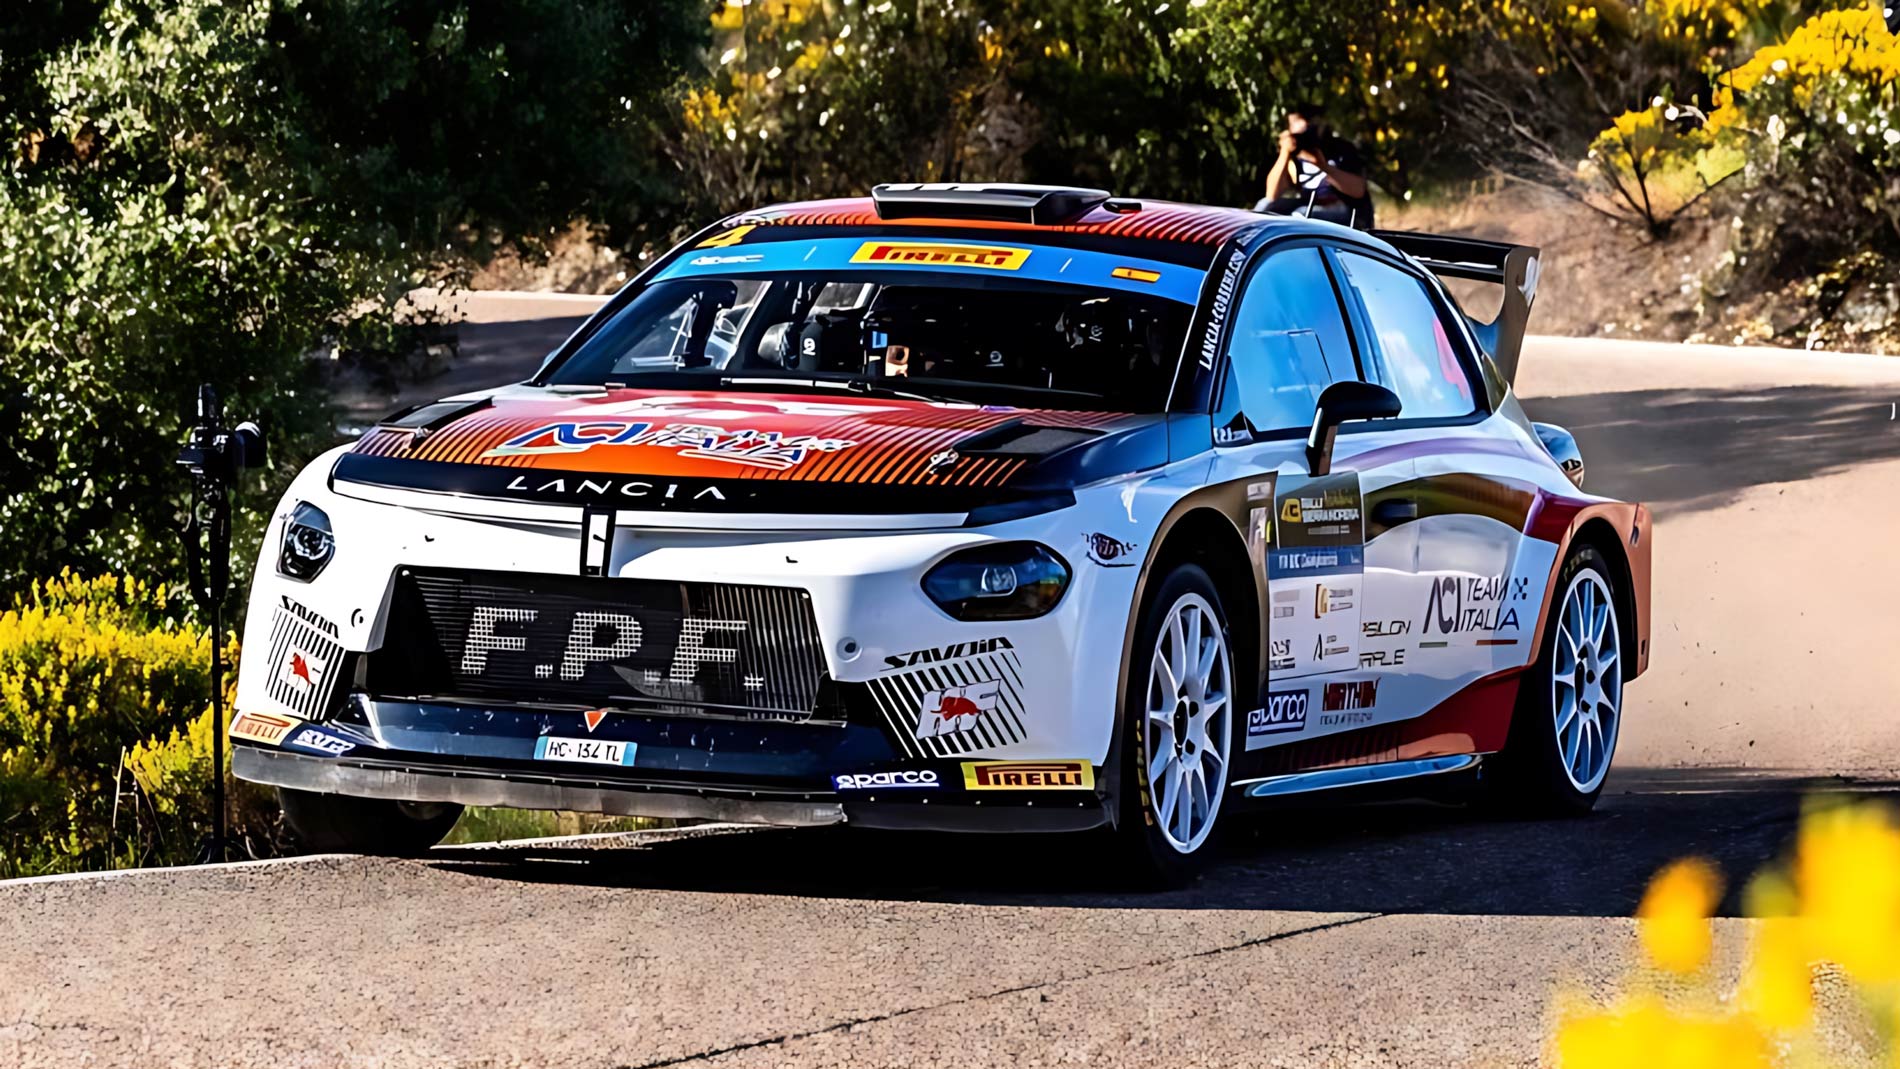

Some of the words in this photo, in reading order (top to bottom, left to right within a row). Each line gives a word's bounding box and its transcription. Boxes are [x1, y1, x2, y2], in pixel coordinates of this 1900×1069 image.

[695, 225, 757, 249] 4
[869, 246, 1013, 266] PIRELLI
[507, 475, 726, 500] LANCIA
[1423, 577, 1461, 634] ACI
[1467, 577, 1510, 602] TEAM
[1460, 608, 1520, 632] ITALIA
[461, 606, 764, 691] F.P.F.
[882, 636, 1015, 670] SAVOIA
[836, 769, 938, 789] sparco
[974, 762, 1083, 786] PIRELLI
